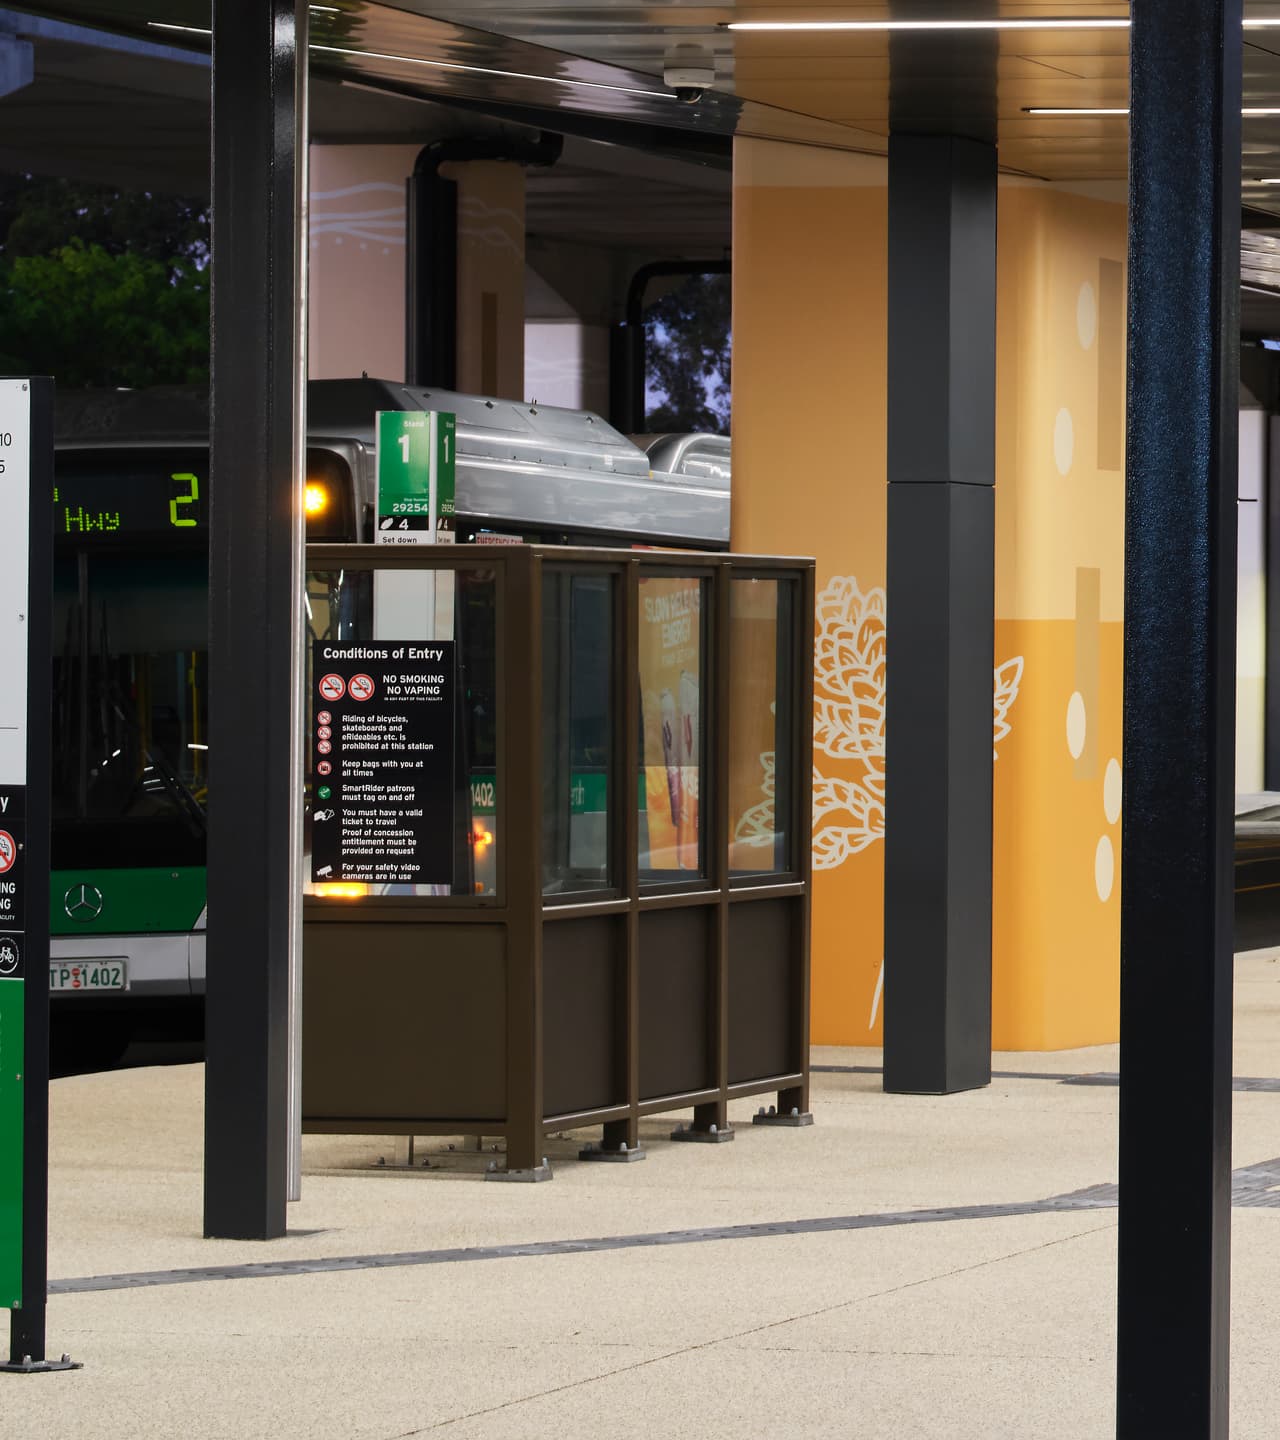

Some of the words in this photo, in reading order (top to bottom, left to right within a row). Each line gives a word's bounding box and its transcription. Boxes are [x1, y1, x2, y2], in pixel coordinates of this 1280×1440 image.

[398, 434, 409, 463] 1
[443, 434, 449, 463] 1
[392, 504, 428, 512] 29254
[65, 507, 120, 532] Hwy
[399, 518, 409, 530] 4
[324, 648, 388, 659] Conditions
[392, 648, 404, 659] of
[408, 648, 443, 661] Entry
[383, 675, 397, 684] NO
[400, 675, 444, 684] SMOKING
[387, 686, 401, 694] NO
[404, 686, 440, 694] VAPING
[342, 715, 365, 723] Riding
[367, 715, 375, 723] of
[377, 715, 408, 723] bicycles,
[342, 760, 360, 768] Keep
[363, 760, 380, 768] bags
[382, 760, 398, 768] with
[400, 760, 414, 768] you
[416, 760, 423, 768] at
[470, 782, 494, 807] 1402
[81, 967, 120, 987] 1402
